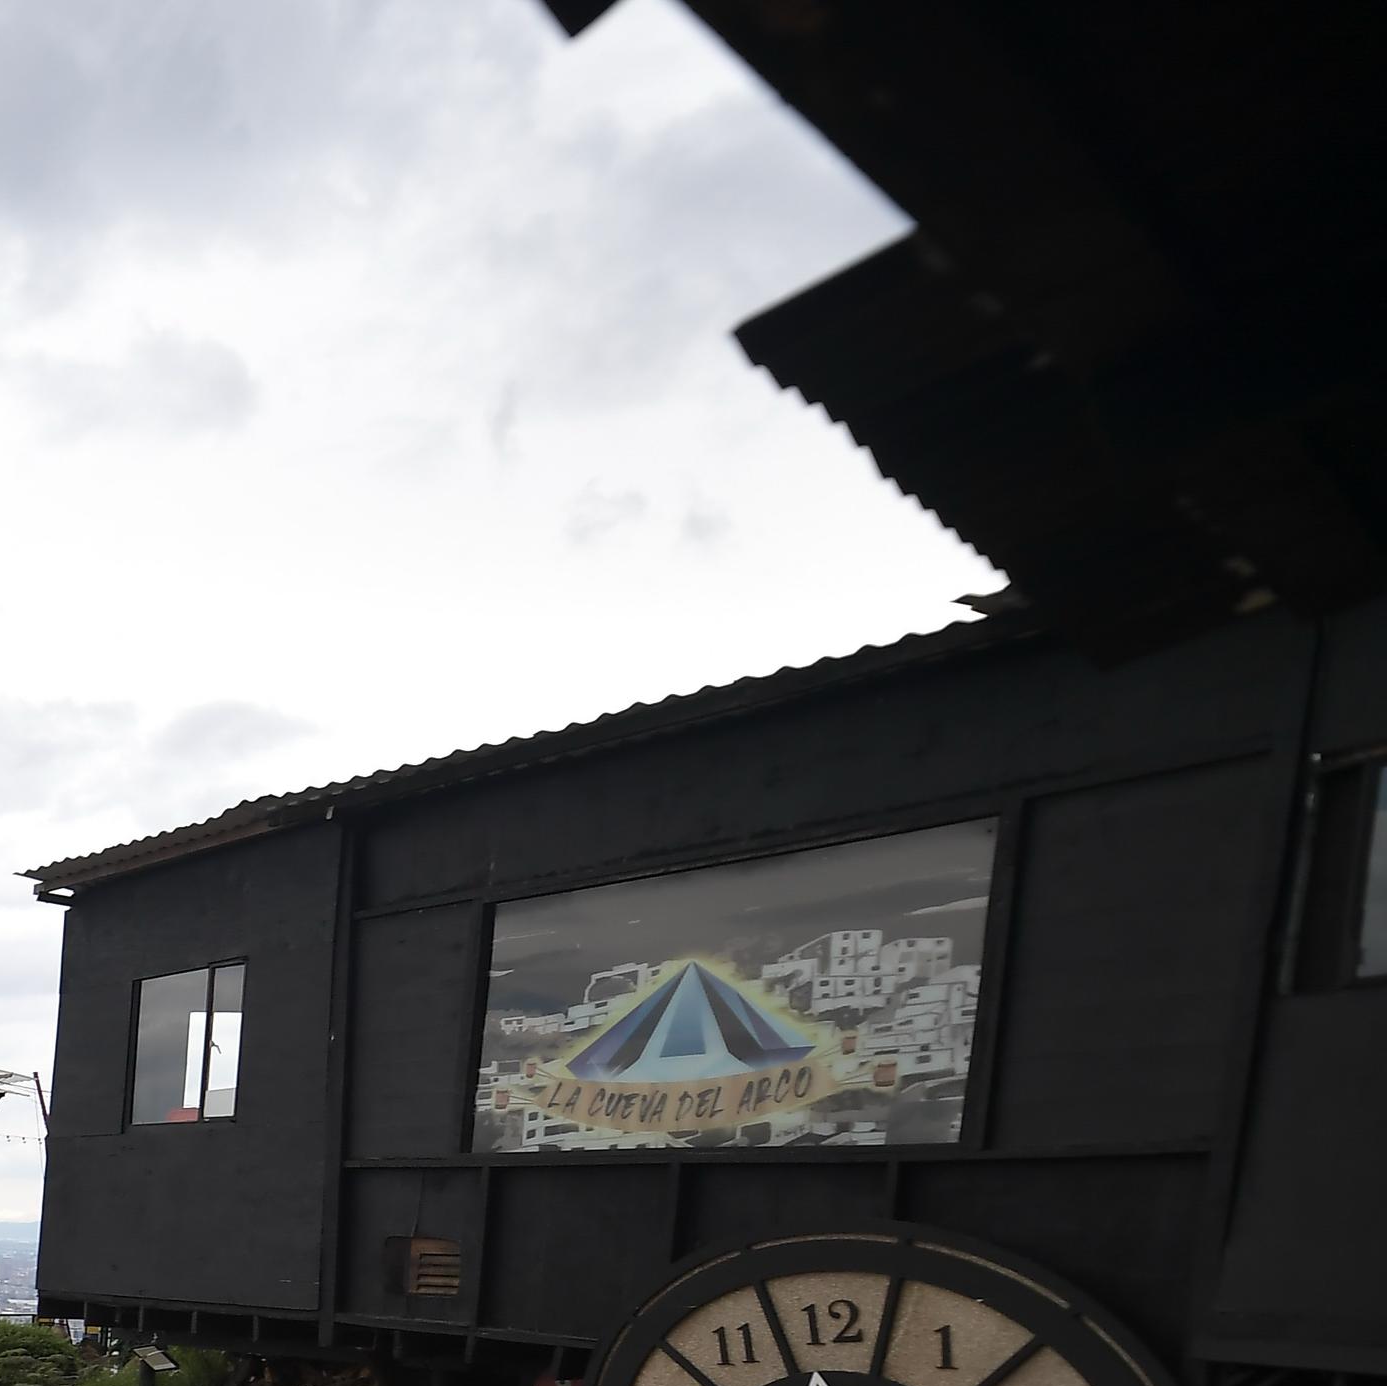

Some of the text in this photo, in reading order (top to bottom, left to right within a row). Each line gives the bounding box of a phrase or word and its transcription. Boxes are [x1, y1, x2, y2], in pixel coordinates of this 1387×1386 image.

[547, 1065, 813, 1123] LA CUEVA DEL ARCO
[711, 1322, 761, 1365] 11
[801, 1300, 864, 1346] 12
[932, 1324, 959, 1371] 1
